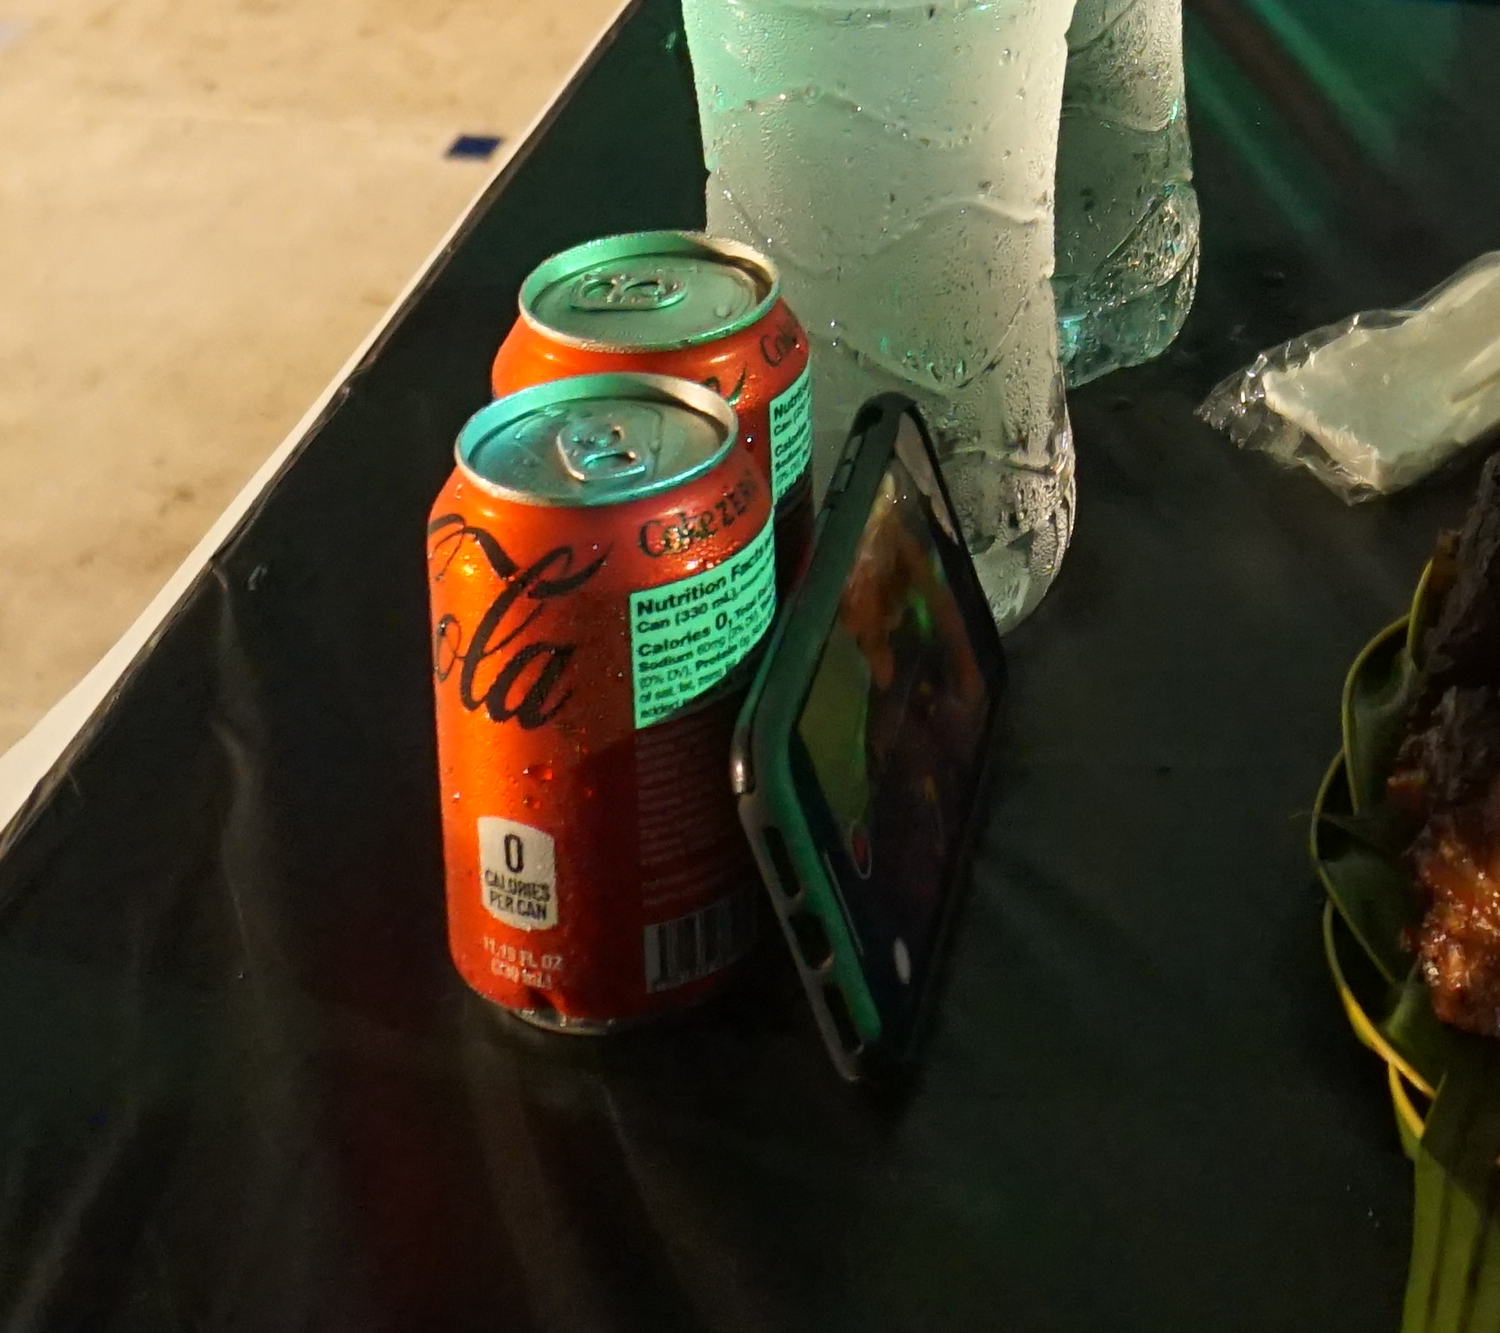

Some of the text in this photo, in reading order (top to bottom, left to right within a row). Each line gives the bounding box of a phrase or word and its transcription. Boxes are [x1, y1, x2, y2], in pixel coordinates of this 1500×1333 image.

[638, 509, 719, 559] Coke
[637, 574, 727, 617] Nutrition
[637, 617, 671, 635] Can
[638, 626, 711, 658] Calories
[503, 833, 524, 873] 0
[484, 868, 551, 902] CALORIES
[489, 889, 548, 921] PER CAN
[519, 949, 538, 968] FL
